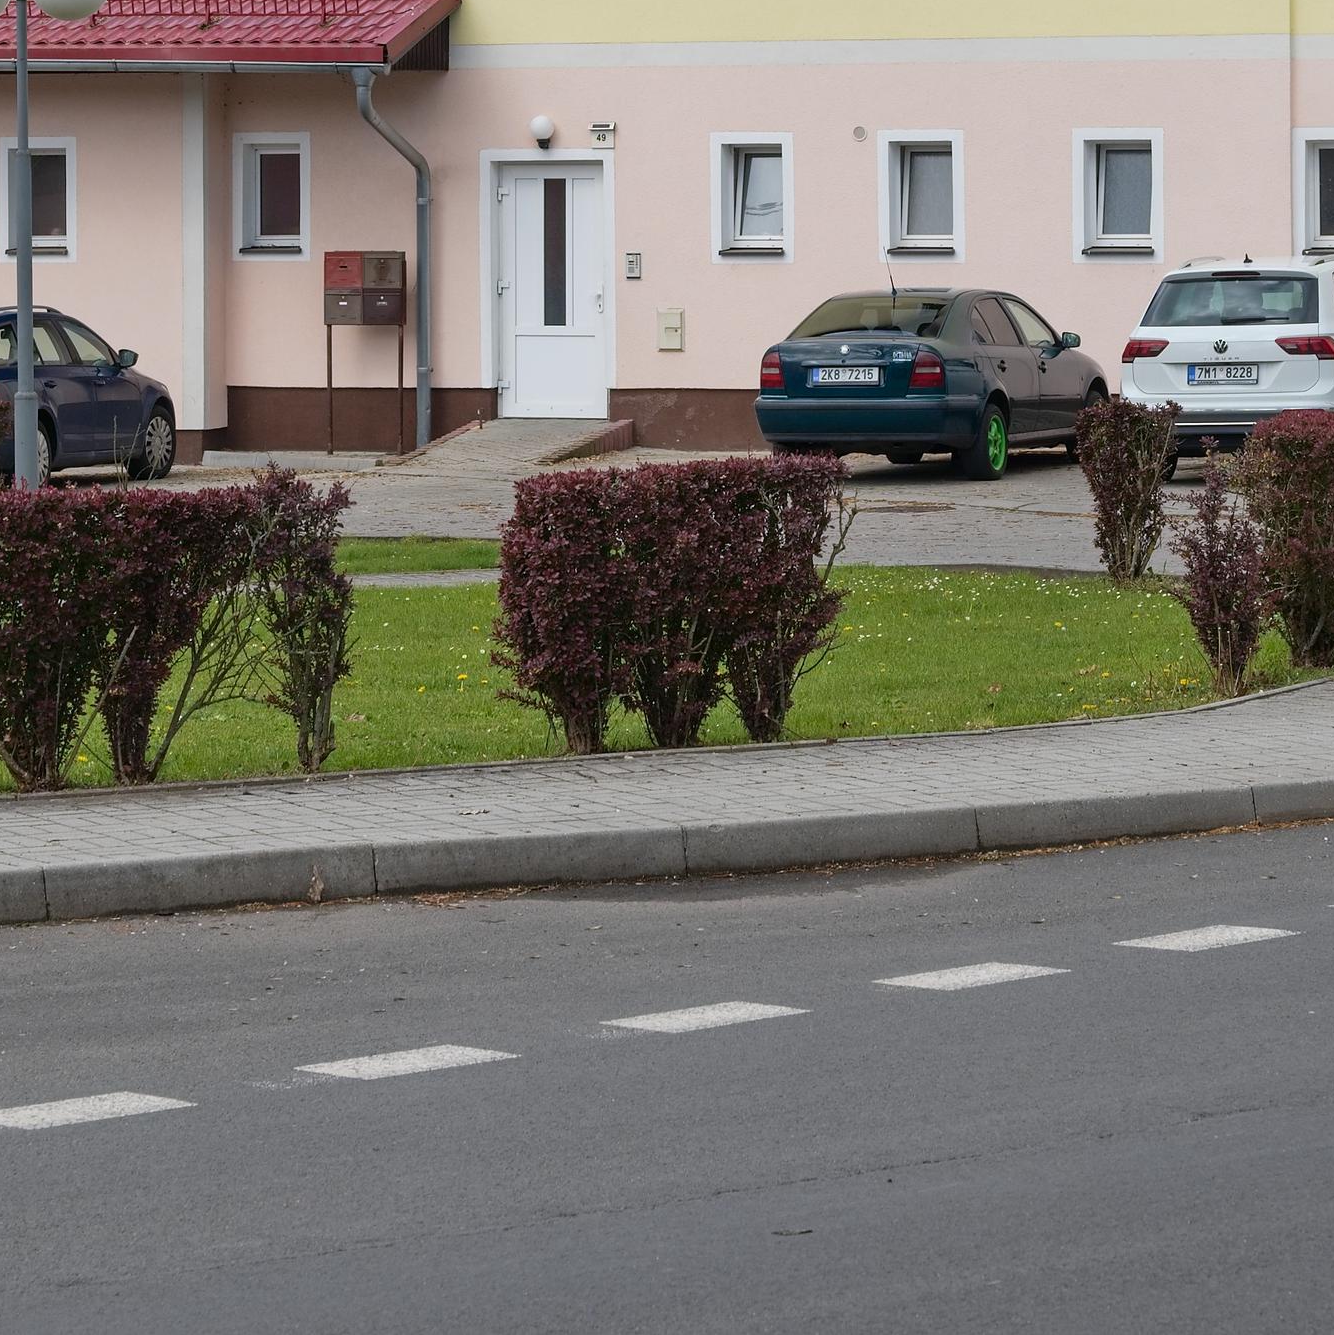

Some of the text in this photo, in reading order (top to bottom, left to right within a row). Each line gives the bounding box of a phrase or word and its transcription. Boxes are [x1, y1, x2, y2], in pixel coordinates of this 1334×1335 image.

[596, 133, 607, 142] 49
[821, 368, 874, 381] 2K8 7215
[1197, 366, 1253, 379] 7M1 8228
